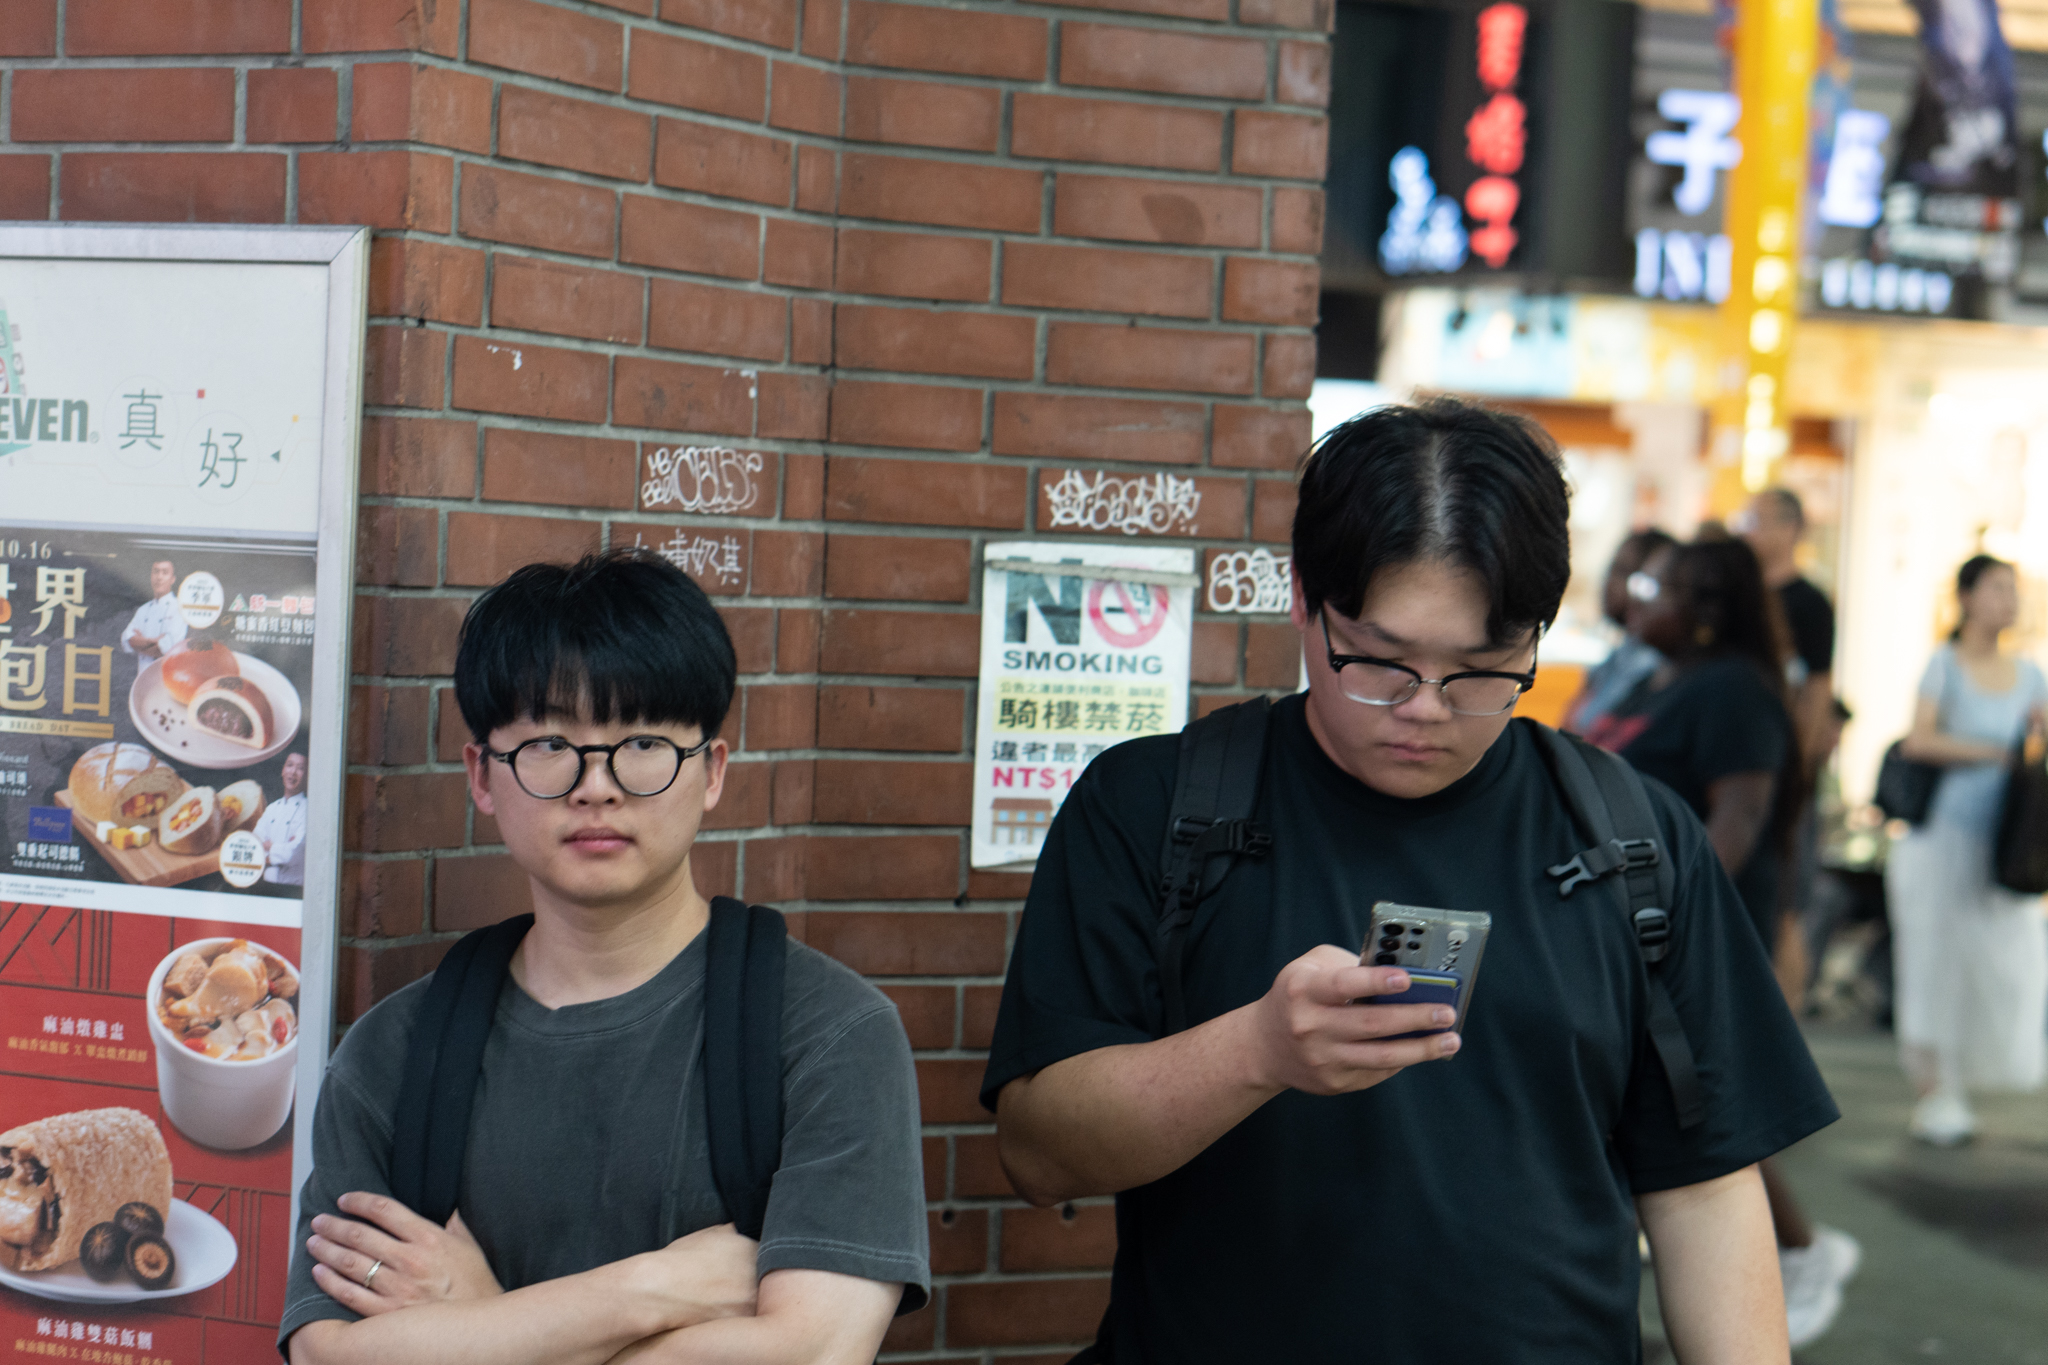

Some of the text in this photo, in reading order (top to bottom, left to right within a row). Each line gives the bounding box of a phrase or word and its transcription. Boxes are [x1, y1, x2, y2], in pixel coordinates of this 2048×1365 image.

[1003, 650, 1163, 675] SMOKING
[49, 722, 70, 733] DAY
[998, 698, 1164, 733] 騎樓禁菸
[992, 766, 1082, 790] NT$1
